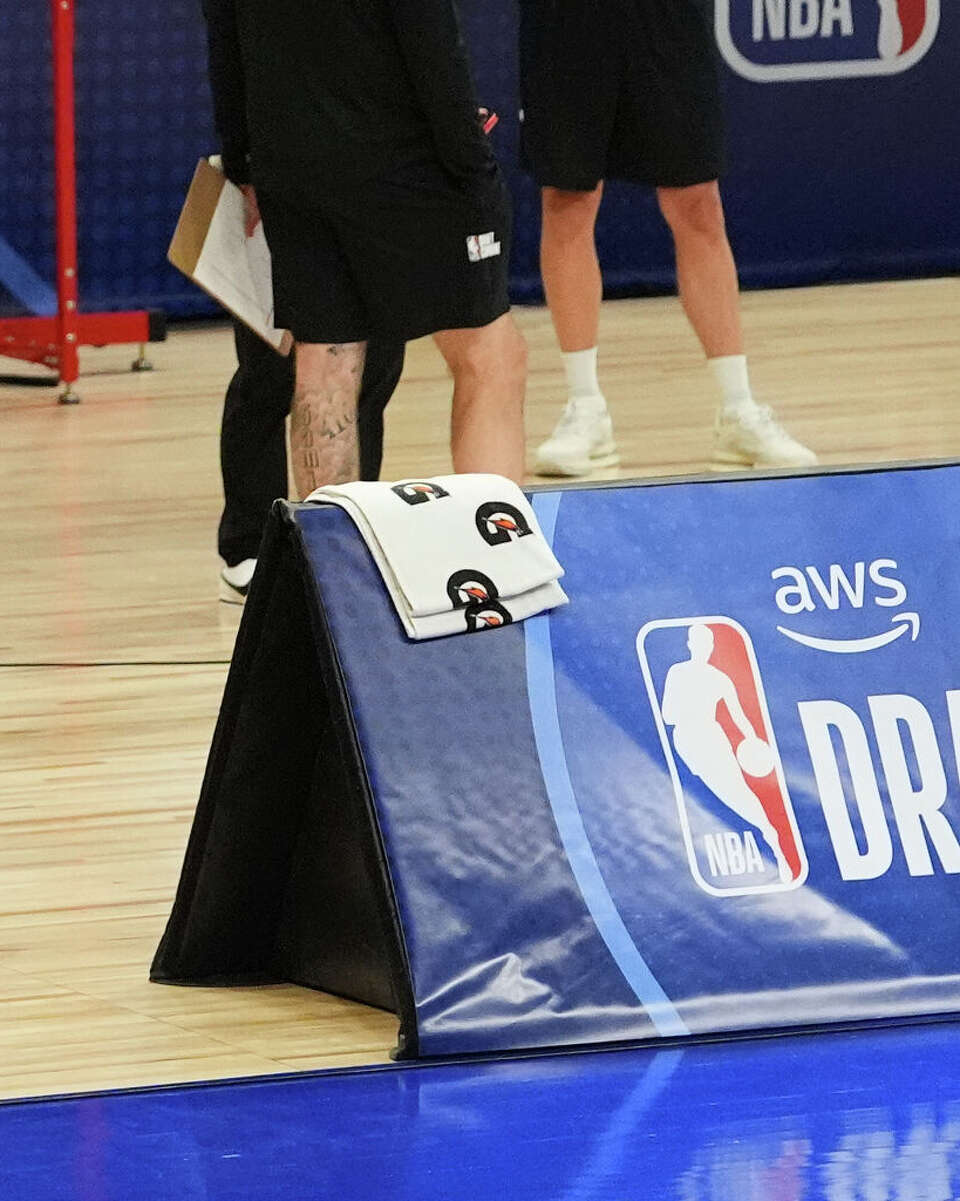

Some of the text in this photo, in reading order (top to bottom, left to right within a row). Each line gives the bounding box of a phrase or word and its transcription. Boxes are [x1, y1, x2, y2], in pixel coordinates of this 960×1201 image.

[771, 557, 908, 615] aws
[797, 689, 960, 882] DR
[703, 830, 766, 877] NBA
